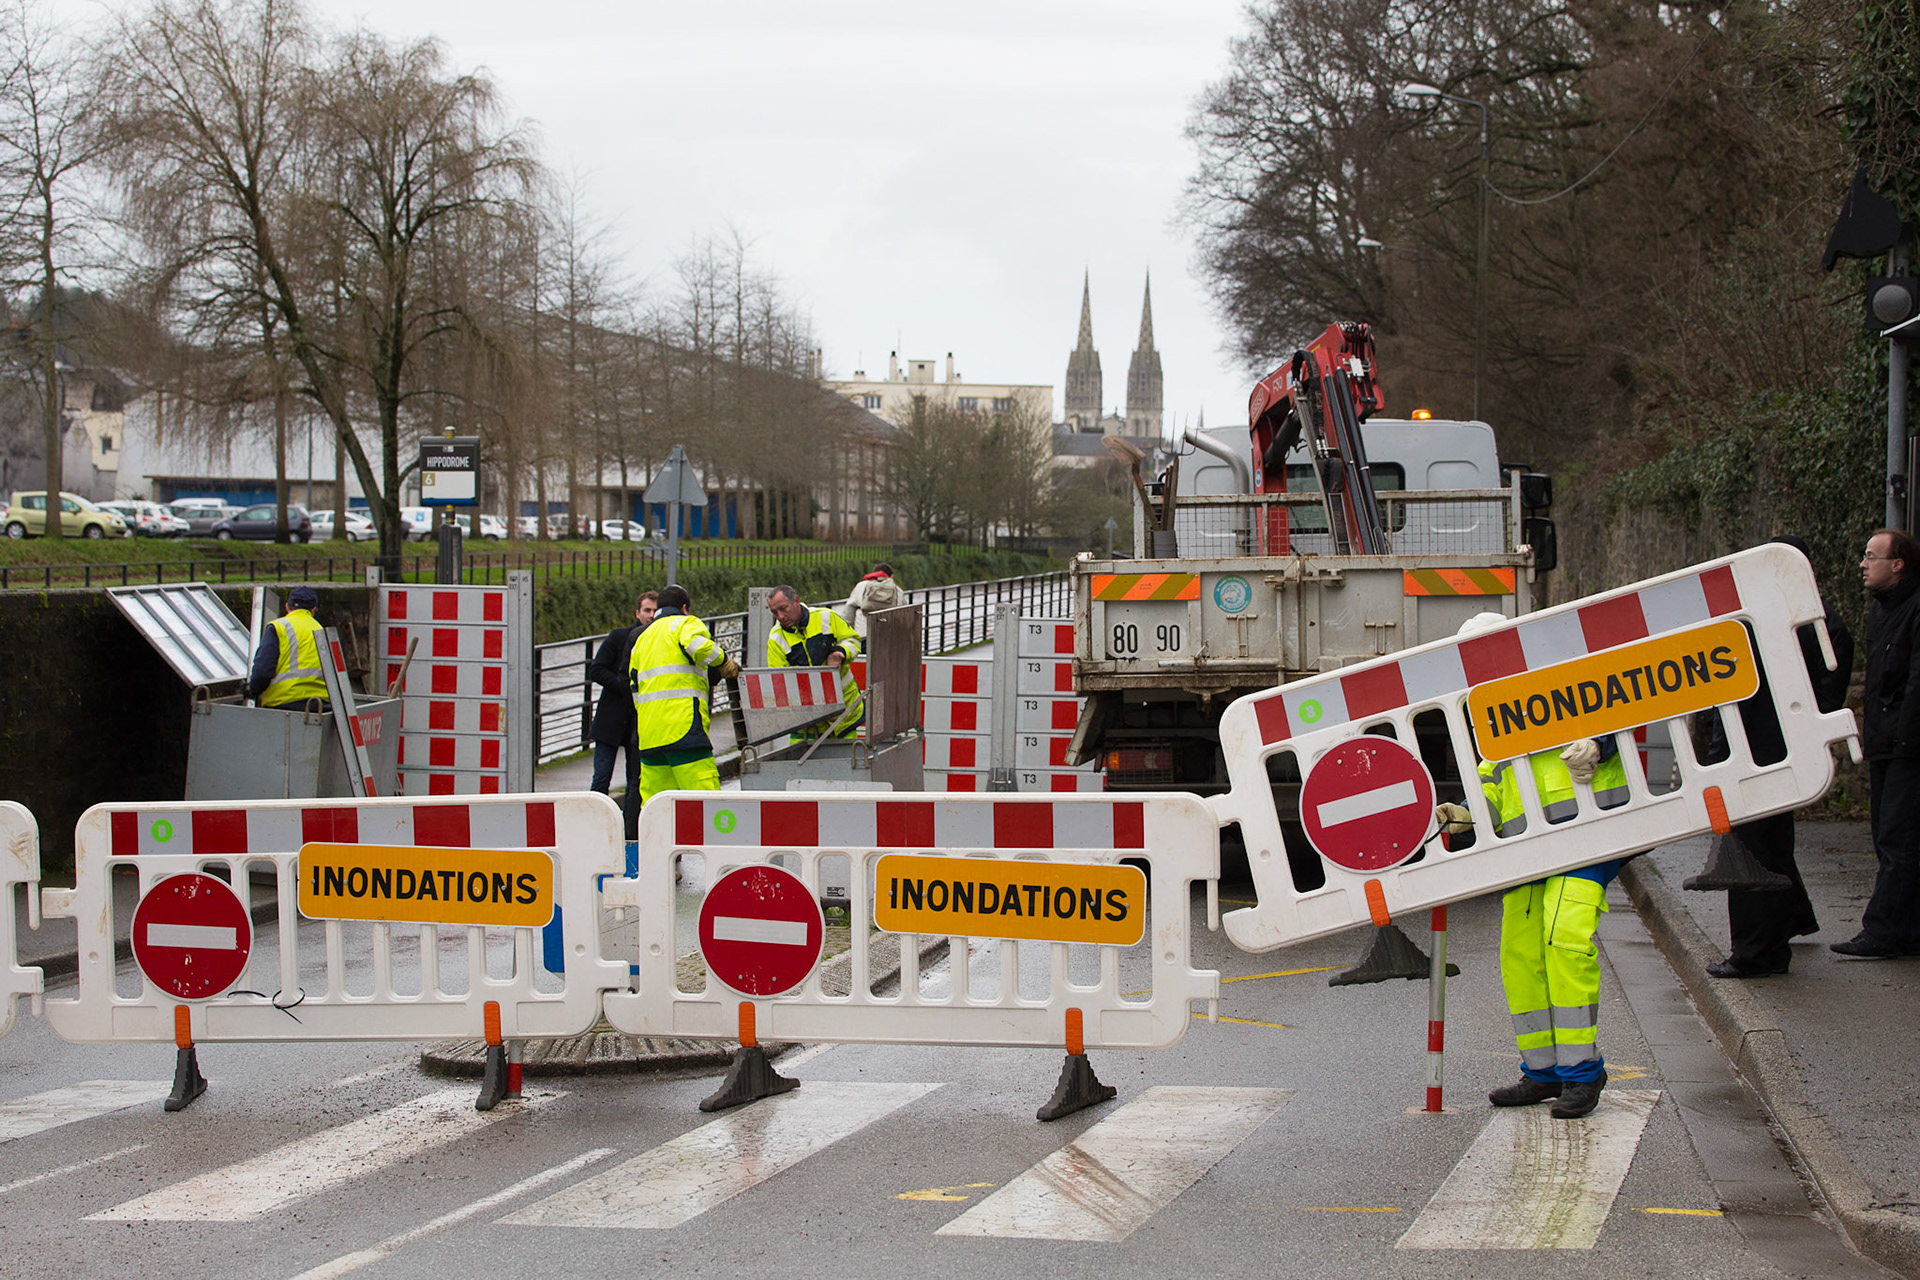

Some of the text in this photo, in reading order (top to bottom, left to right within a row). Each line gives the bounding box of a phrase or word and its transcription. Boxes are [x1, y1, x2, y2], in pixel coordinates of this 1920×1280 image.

[427, 456, 470, 468] HIPPODROME
[425, 474, 433, 485] 6
[388, 591, 402, 600] T6
[388, 627, 402, 637] T6
[1028, 624, 1042, 635] T3
[1113, 624, 1138, 653] 80
[1156, 624, 1180, 651] 90
[388, 664, 401, 674] T6
[1027, 662, 1041, 672] T3
[1486, 646, 1737, 738] INONDATIONS
[1024, 700, 1038, 710] T3
[1024, 736, 1038, 747] T3
[1023, 773, 1037, 784] T3
[313, 865, 537, 905] INONDATIONS
[890, 878, 1128, 922] INONDATIONS
